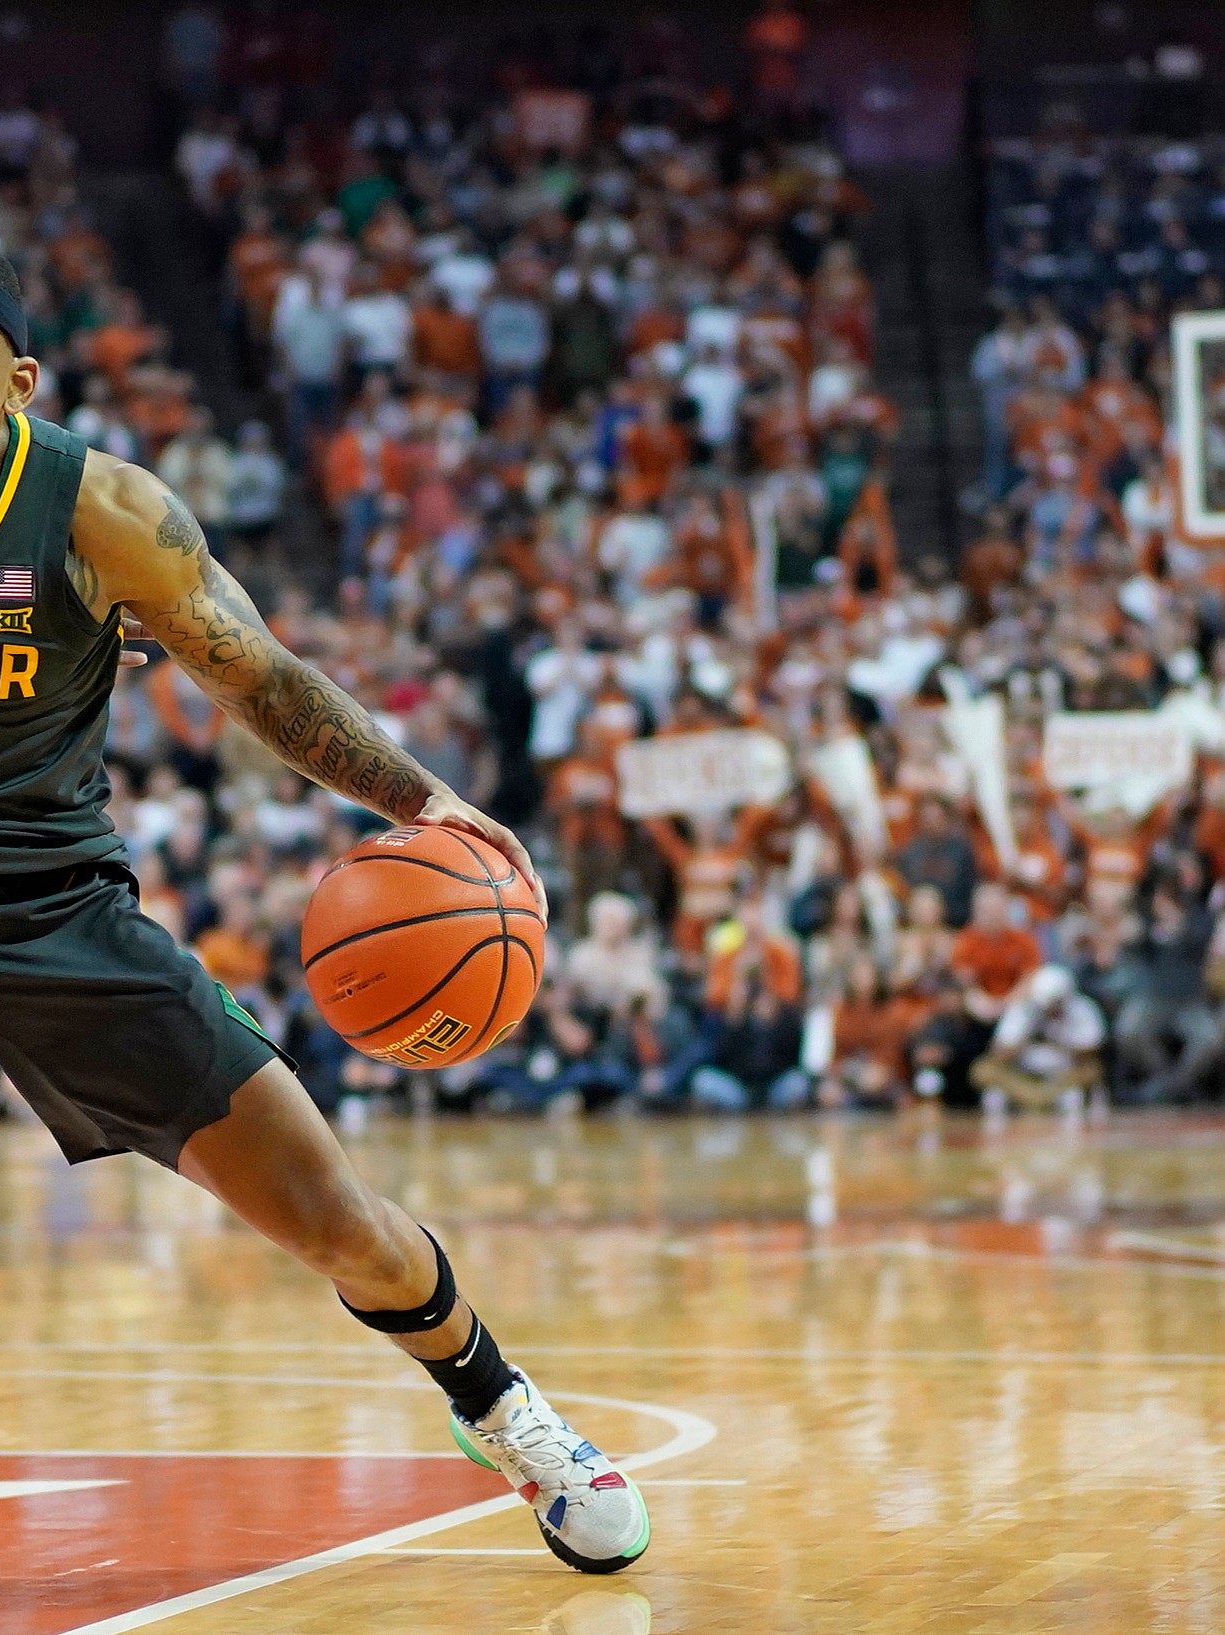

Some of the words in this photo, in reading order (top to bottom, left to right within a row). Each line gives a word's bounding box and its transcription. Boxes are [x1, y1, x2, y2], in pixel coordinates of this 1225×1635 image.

[276, 694, 321, 761] Have
[381, 772, 415, 815] oney
[374, 1014, 473, 1066] ELIT
